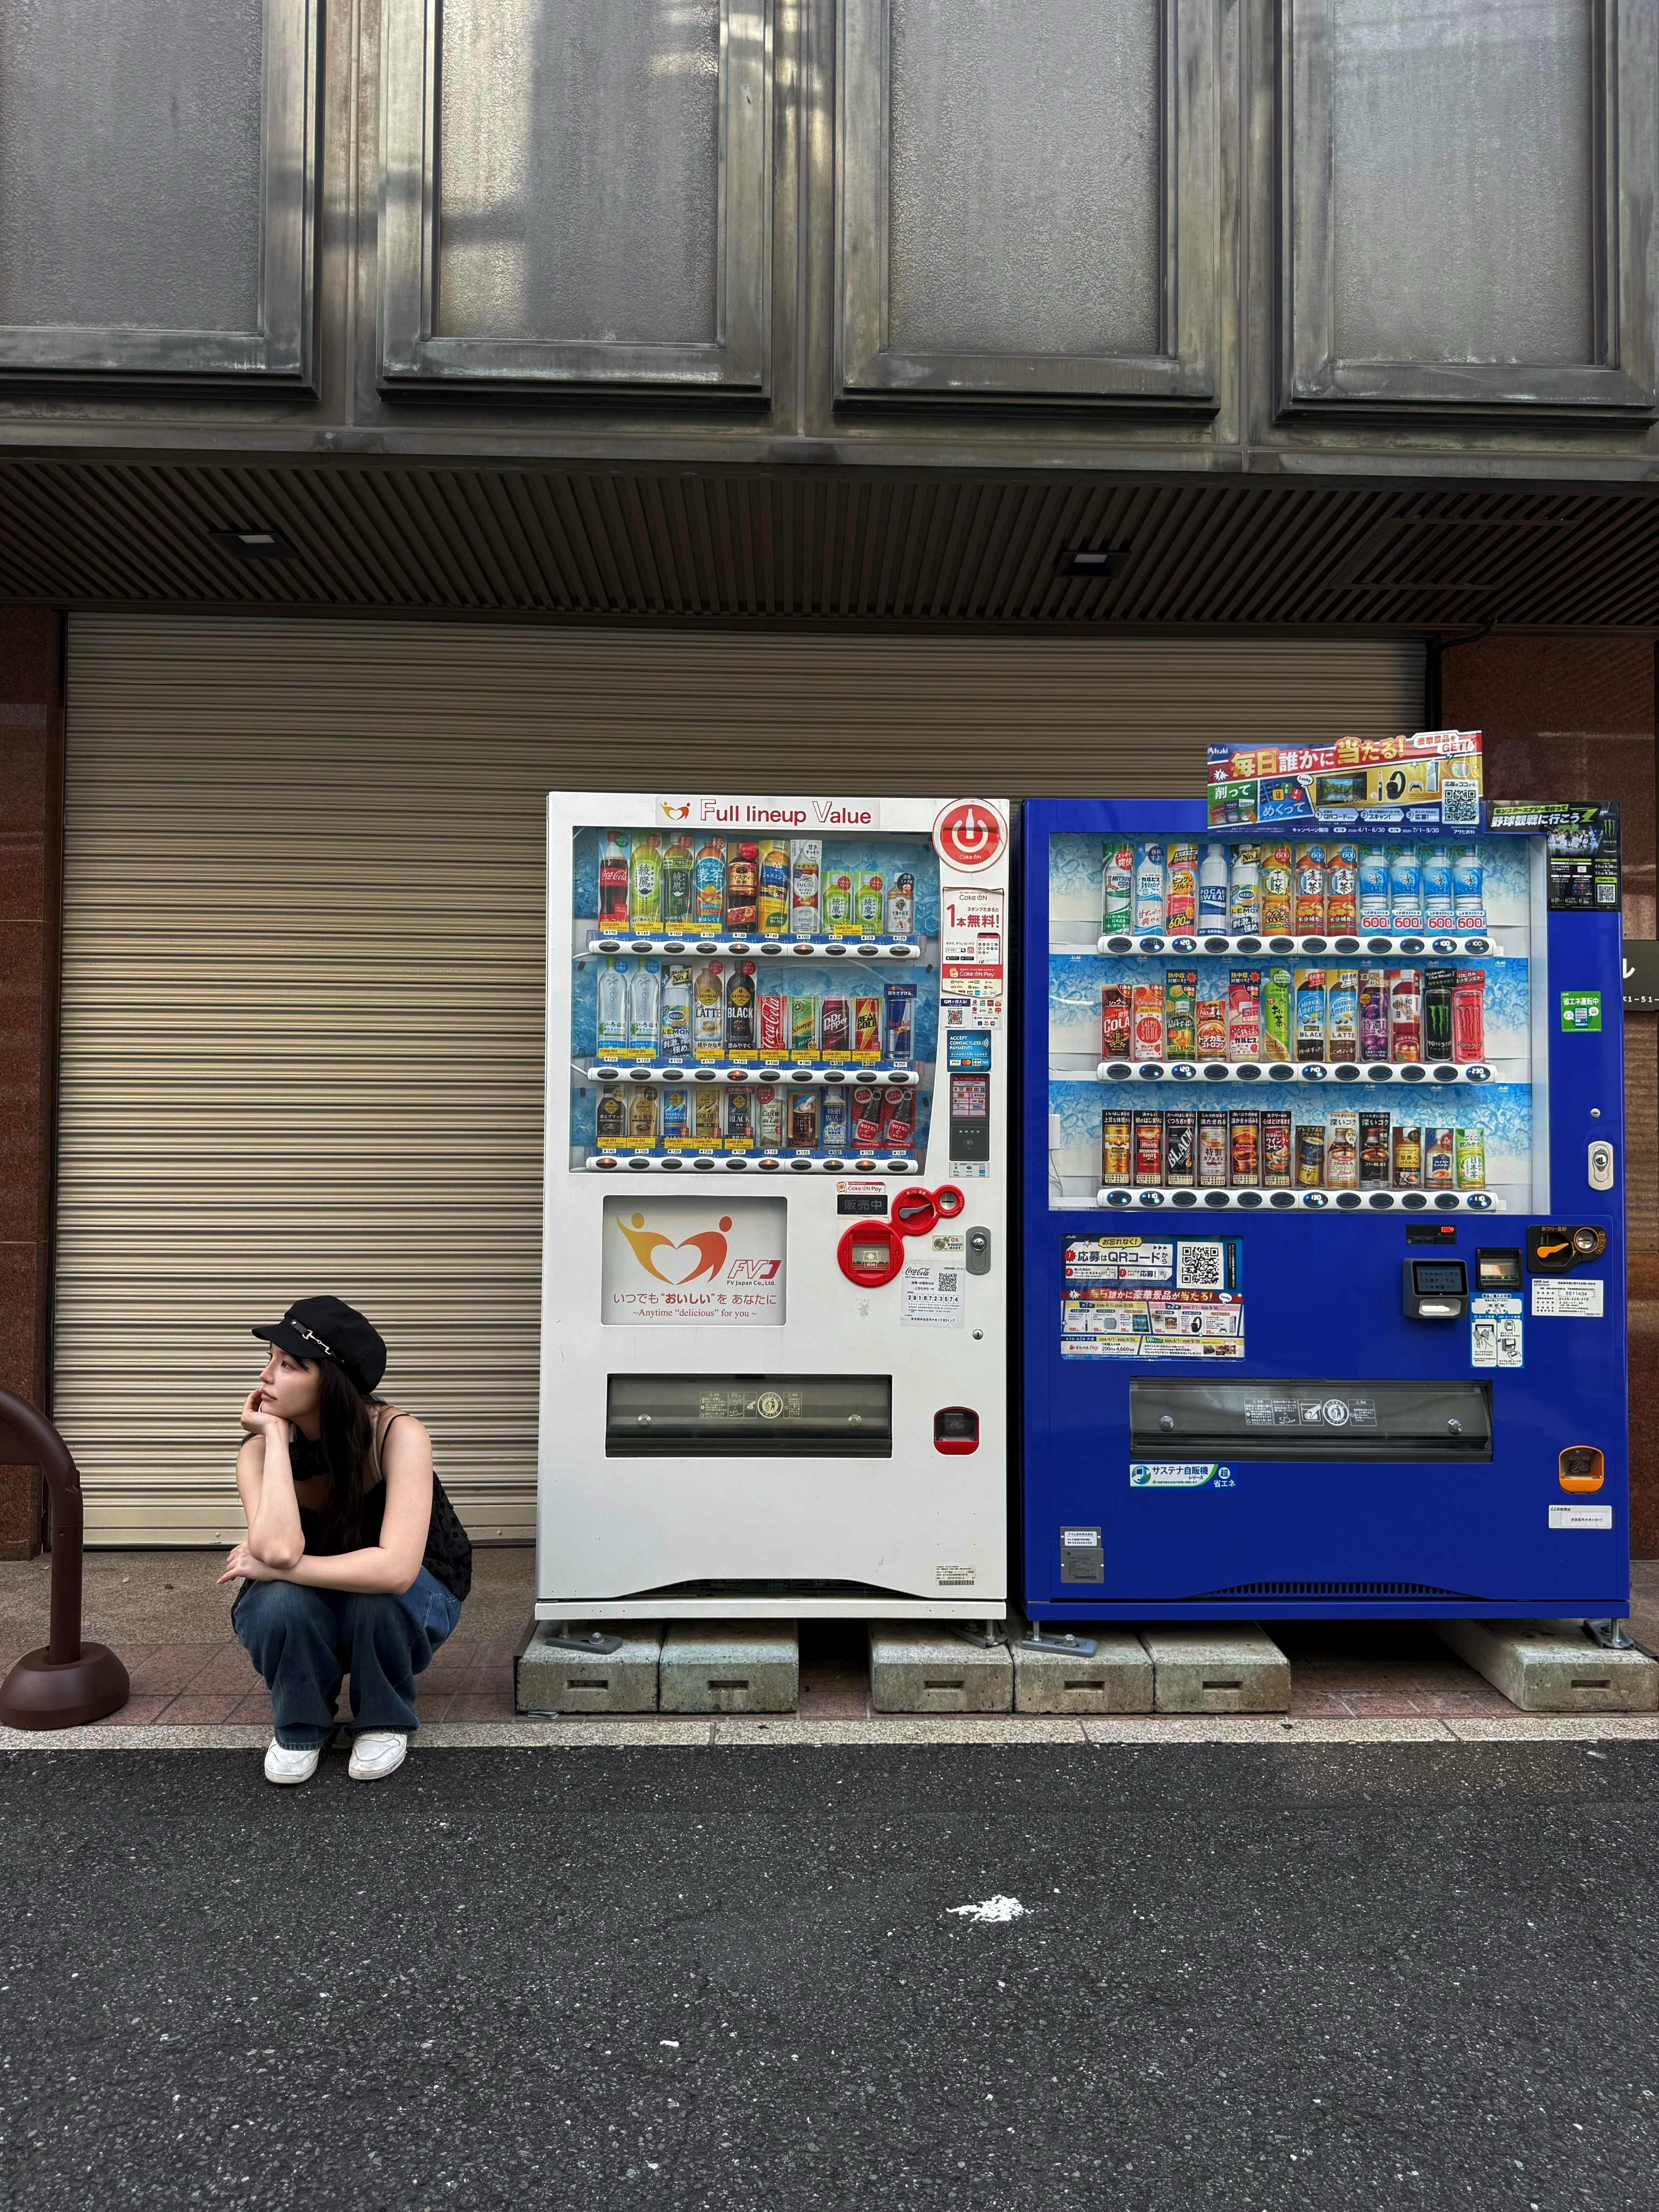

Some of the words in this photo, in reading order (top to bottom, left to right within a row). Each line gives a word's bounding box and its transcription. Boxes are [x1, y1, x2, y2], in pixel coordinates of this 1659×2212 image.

[1418, 734, 1456, 745] 豪華景品を
[1442, 741, 1469, 752] GET!
[1215, 784, 1251, 800] 削って
[700, 799, 739, 821] Full
[747, 806, 806, 826] lineup
[812, 801, 871, 824] Value
[1263, 801, 1306, 817] めくって
[1491, 813, 1580, 827] 野球観戦に行こう
[1243, 852, 1259, 861] No.1
[638, 864, 651, 888] 綾鷹
[697, 868, 724, 883] 麦茶
[1141, 881, 1161, 889] Water
[1307, 870, 1318, 894] 麦茶
[1338, 870, 1350, 894] 麦茶
[947, 904, 999, 928] 1本無料!
[673, 972, 691, 981] No.1
[1563, 997, 1599, 1006] 省エネ運転中
[696, 1008, 721, 1018] LATTE
[727, 1008, 753, 1019] BLACK
[858, 1013, 876, 1021] REAL
[824, 1017, 847, 1031] Pepper
[858, 1020, 876, 1030] GOLD
[1104, 1017, 1130, 1033] COLA
[1141, 1028, 1158, 1040] SODA
[1470, 1156, 1478, 1179] 日本茶
[844, 1199, 882, 1211] 販売中
[727, 1259, 782, 1279] FVJ
[732, 1293, 777, 1305] あなたに
[1152, 1466, 1209, 1475] サステナ自販機
[1220, 1469, 1229, 1477] 超
[1213, 1480, 1236, 1488] 省エネ
